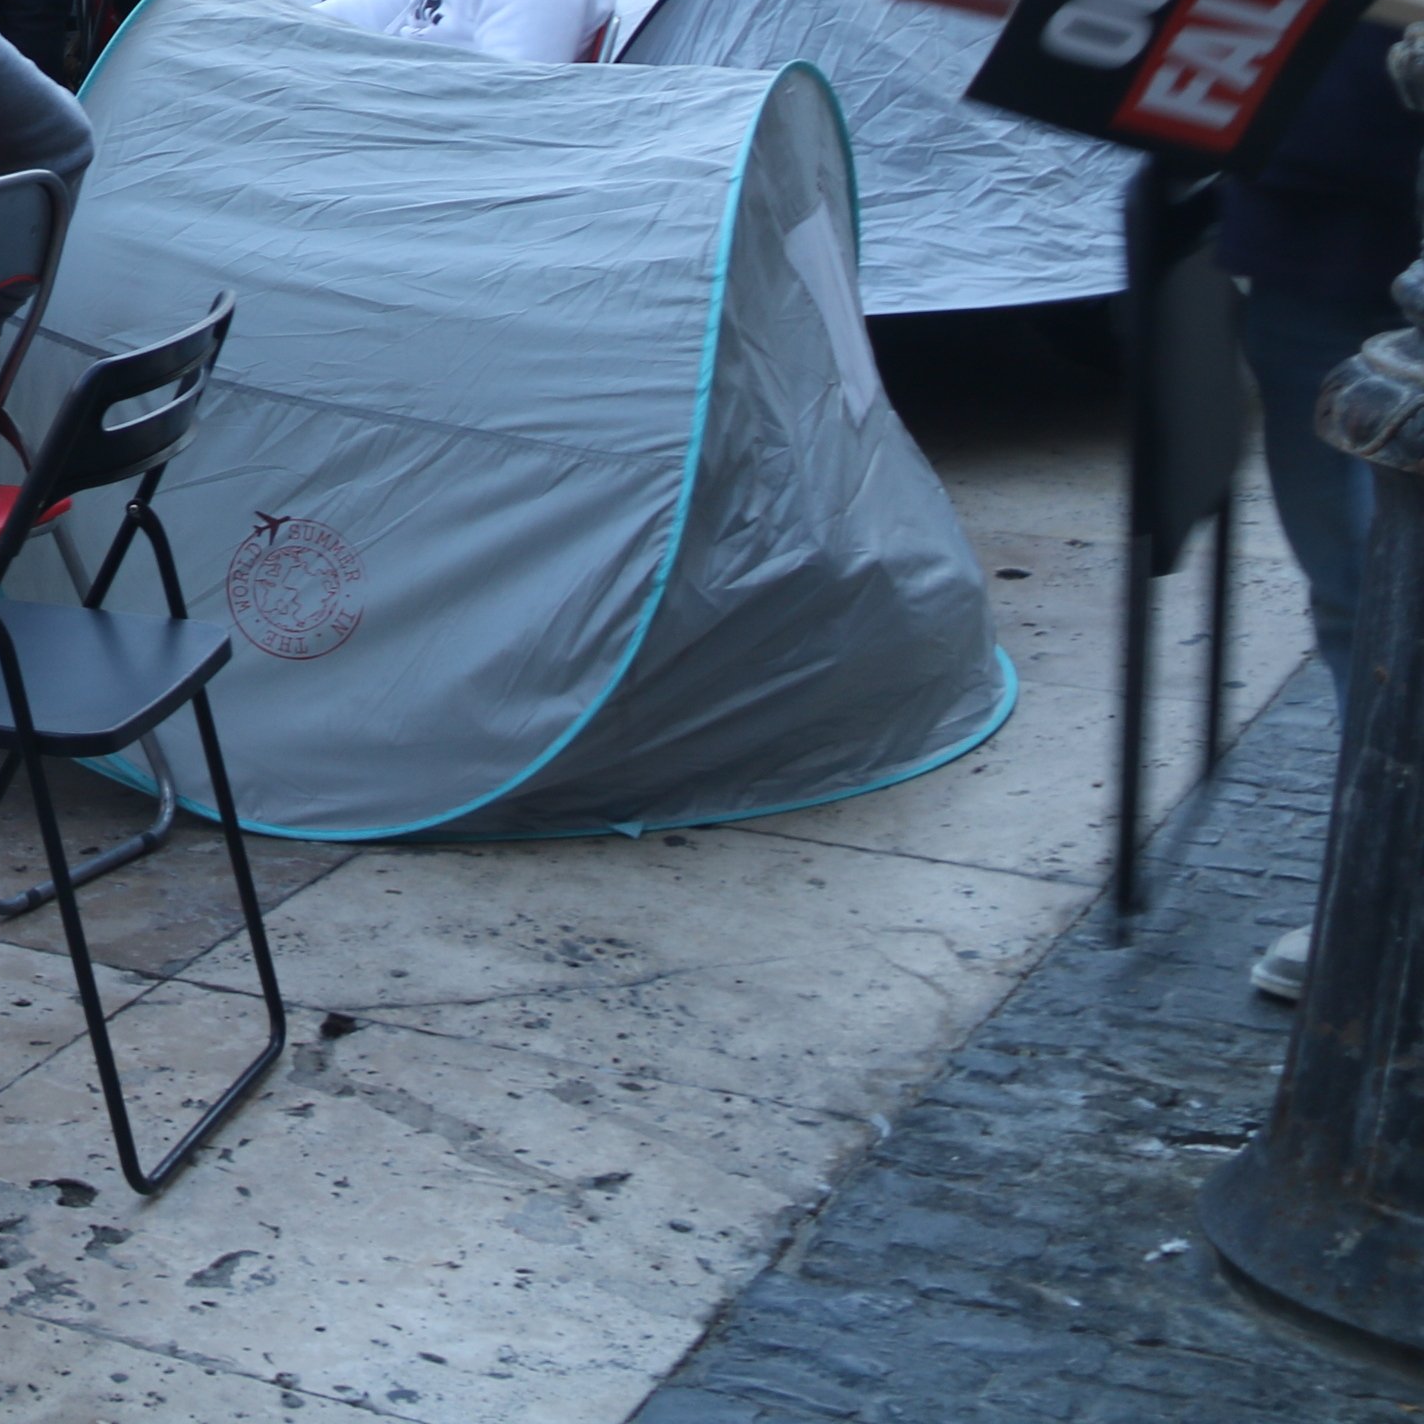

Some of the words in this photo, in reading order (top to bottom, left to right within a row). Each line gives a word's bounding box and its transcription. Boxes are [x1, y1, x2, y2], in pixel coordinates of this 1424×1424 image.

[288, 524, 361, 583] SUMMER
[233, 542, 262, 613] WORLD
[263, 629, 309, 654] THE
[329, 608, 356, 636] IN
